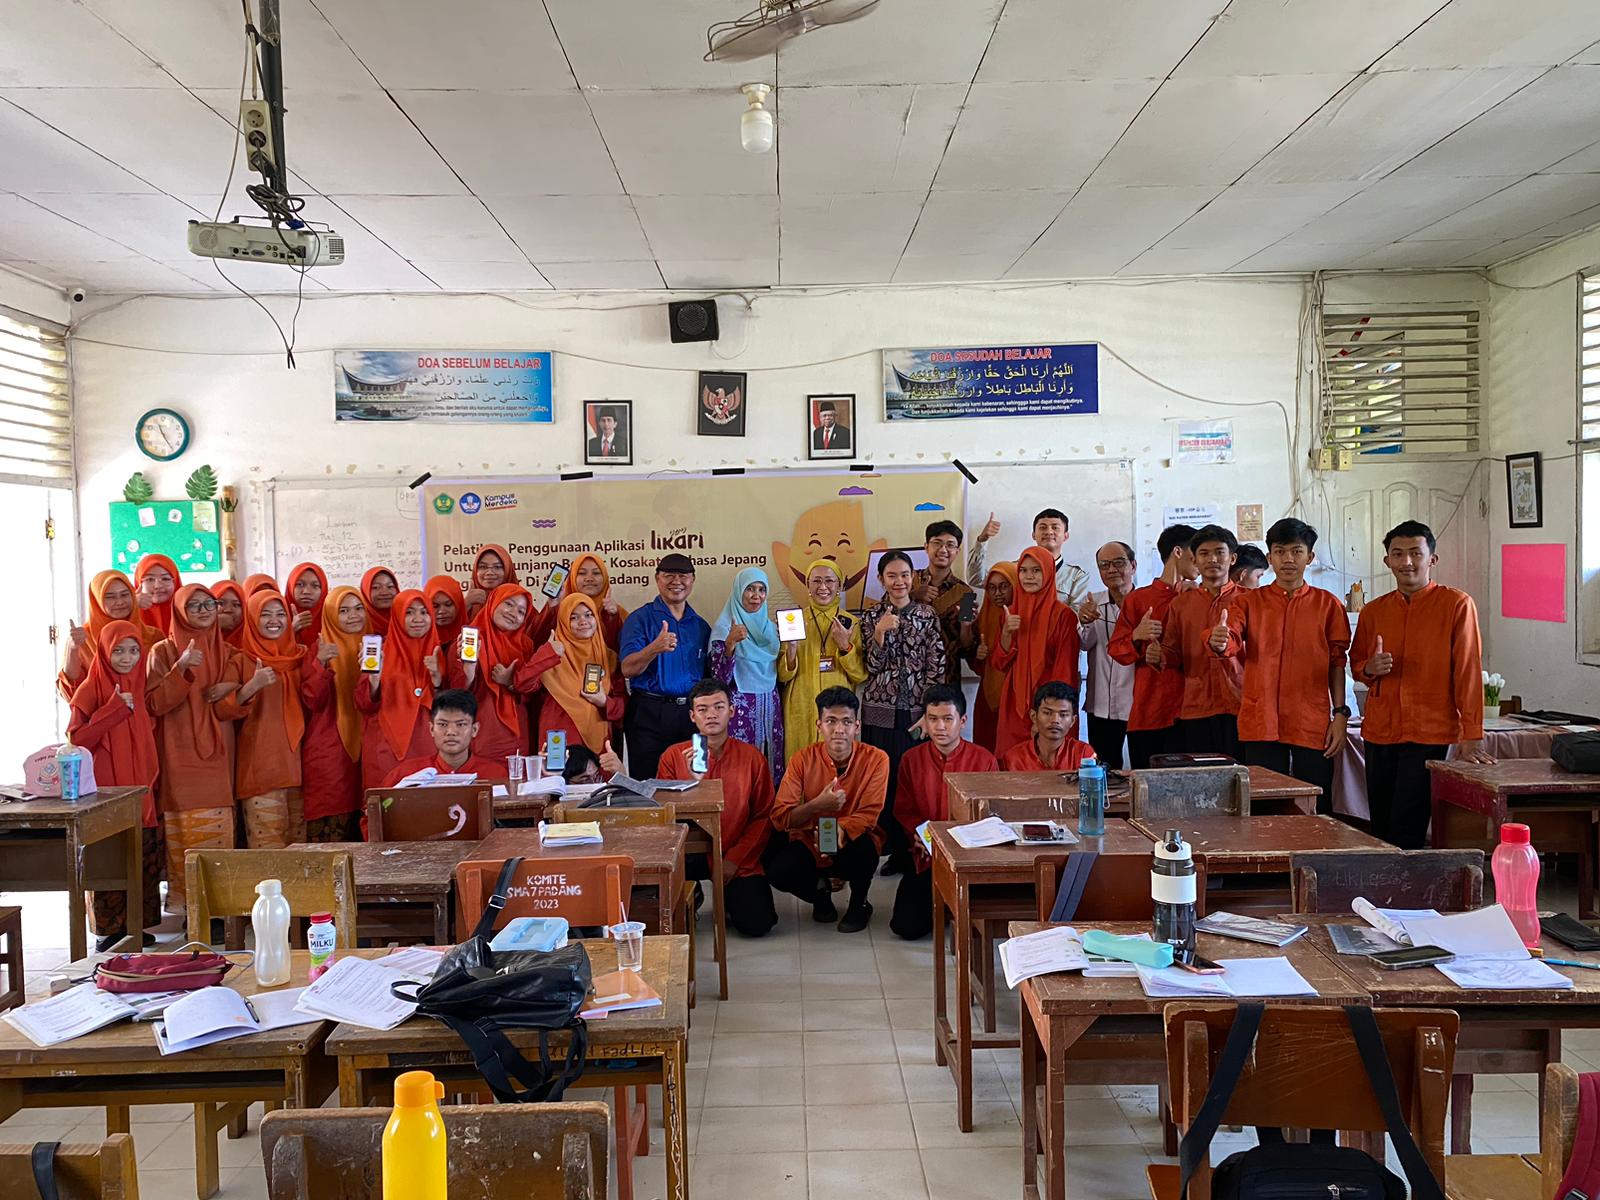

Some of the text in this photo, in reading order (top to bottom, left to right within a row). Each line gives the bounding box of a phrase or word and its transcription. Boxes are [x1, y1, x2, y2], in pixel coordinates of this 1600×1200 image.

[930, 347, 1053, 363] DOA SESUDAH BELAJAR
[418, 357, 542, 369] DOA SEBELUM BELAJAR
[484, 493, 515, 502] Kampus
[484, 499, 518, 508] Merdeka
[443, 530, 704, 556] Pelati Penggunaan Aplikasi likari
[444, 561, 473, 573] Untu
[610, 556, 661, 568] Kosakat
[688, 555, 717, 566] hasa
[720, 554, 767, 567] Jepang
[526, 575, 540, 587] Di
[609, 573, 650, 587] adang
[526, 874, 567, 886] KOMITE
[506, 885, 582, 899] SMA 7 PADANG
[533, 899, 559, 910] 2023
[310, 938, 334, 948] MILKU
